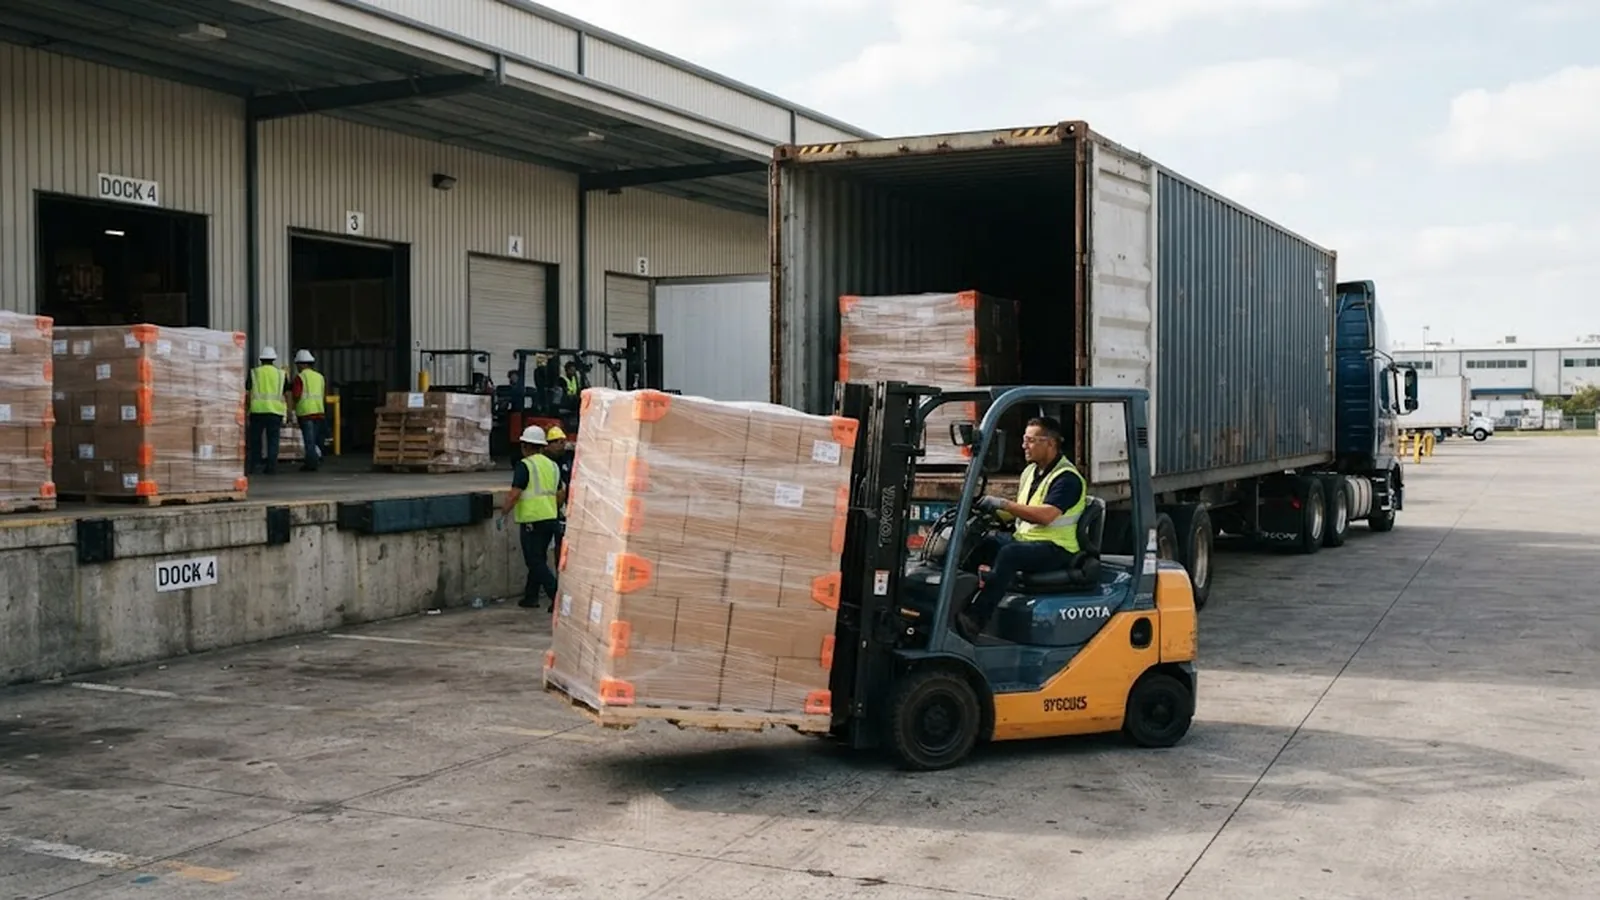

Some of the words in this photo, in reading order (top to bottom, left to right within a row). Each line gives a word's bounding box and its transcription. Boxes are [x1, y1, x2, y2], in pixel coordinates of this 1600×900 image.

[101, 176, 143, 201] DOCK
[147, 184, 156, 202] 4
[350, 214, 359, 231] 3
[158, 562, 201, 586] DOCK
[206, 561, 214, 578] 4
[1059, 606, 1111, 620] TOYOTA
